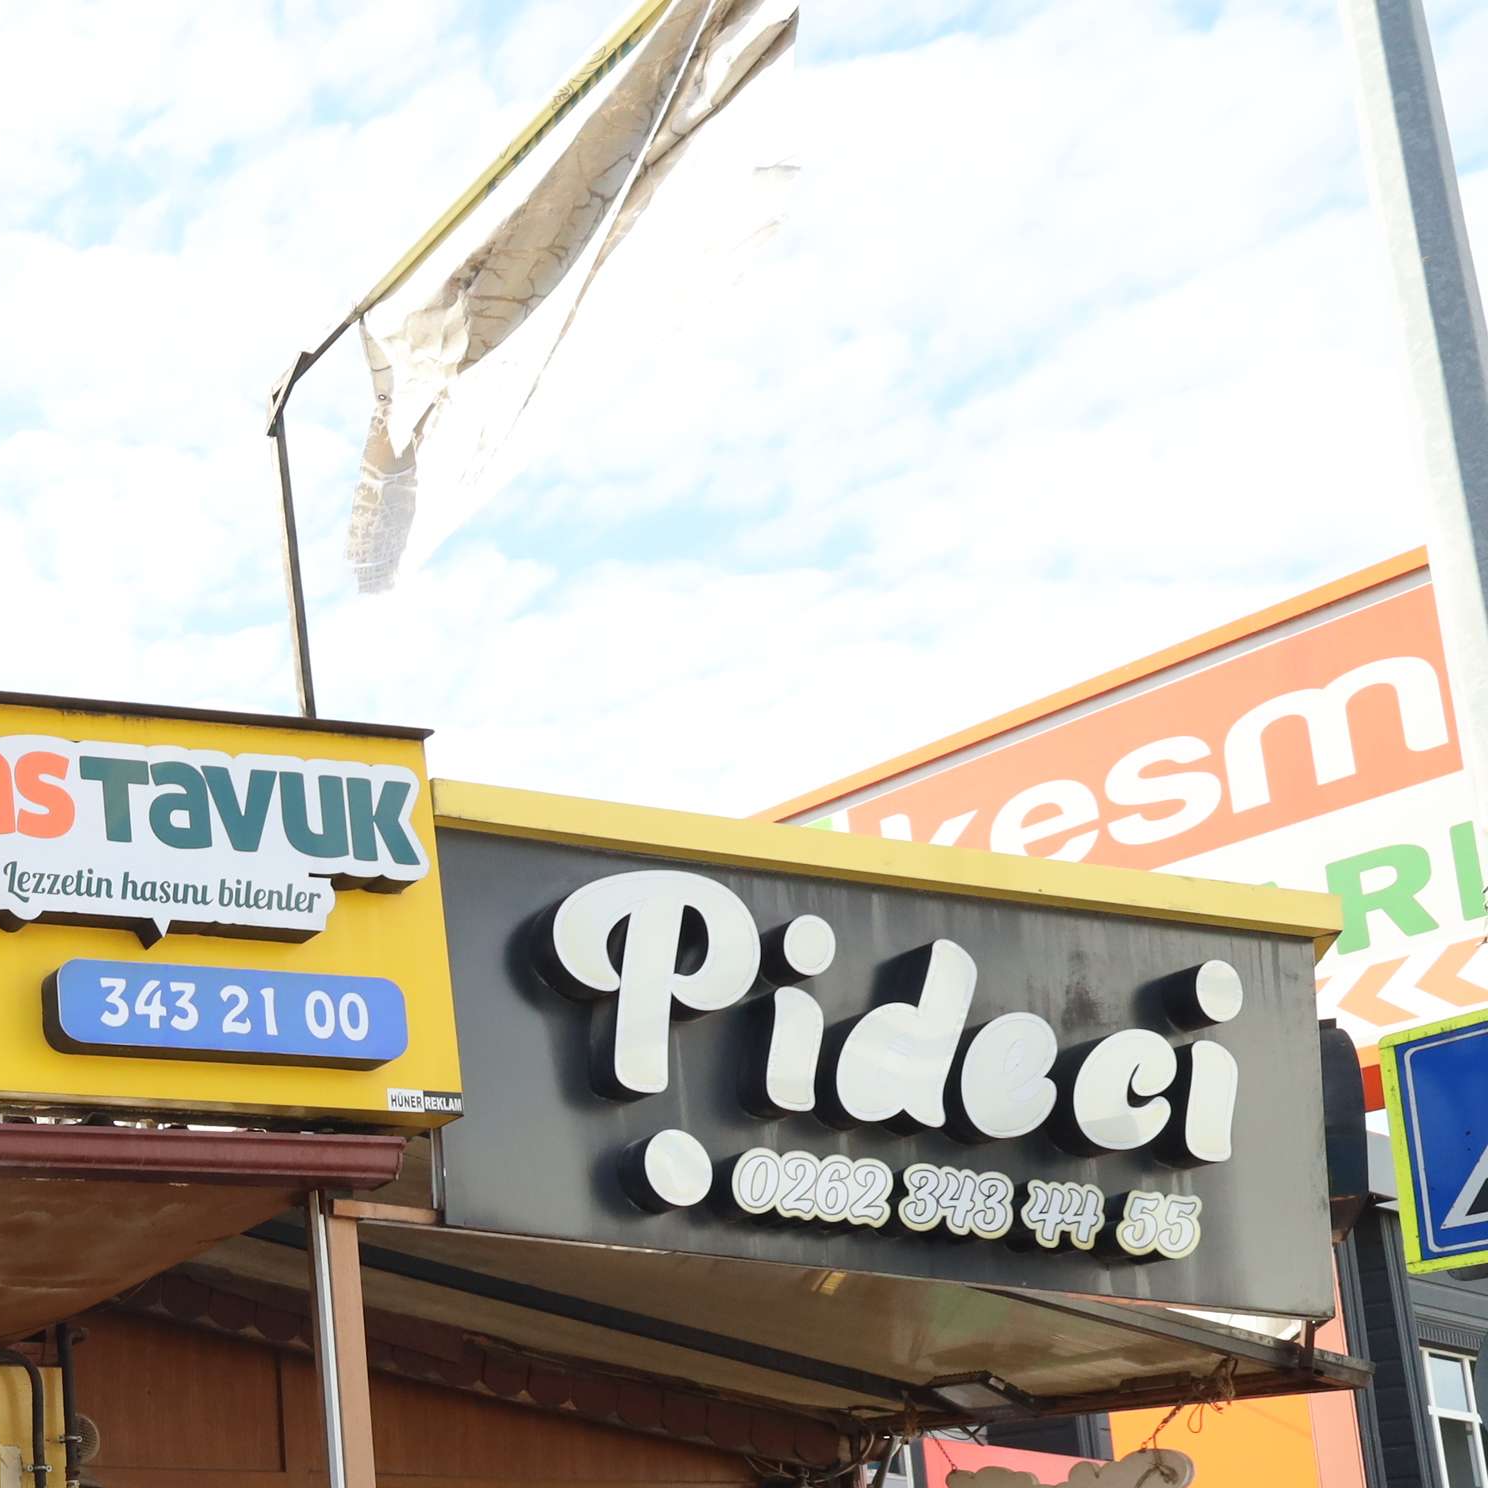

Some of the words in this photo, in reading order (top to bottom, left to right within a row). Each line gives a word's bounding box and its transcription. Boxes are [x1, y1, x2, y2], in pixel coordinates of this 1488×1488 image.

[2, 860, 114, 900] Lezzetin
[121, 870, 214, 906] hasını
[218, 876, 322, 914] bilenler
[99, 977, 199, 1031] 343
[219, 985, 278, 1037] 21
[305, 991, 369, 1042] 00
[552, 869, 1244, 1163] Pideci
[390, 1092, 424, 1108] HÜNER
[425, 1095, 463, 1112] REKLAM
[733, 1148, 892, 1228] 0262
[899, 1163, 1014, 1239] 343
[1023, 1180, 1105, 1250] 44
[1117, 1191, 1202, 1259] 55
